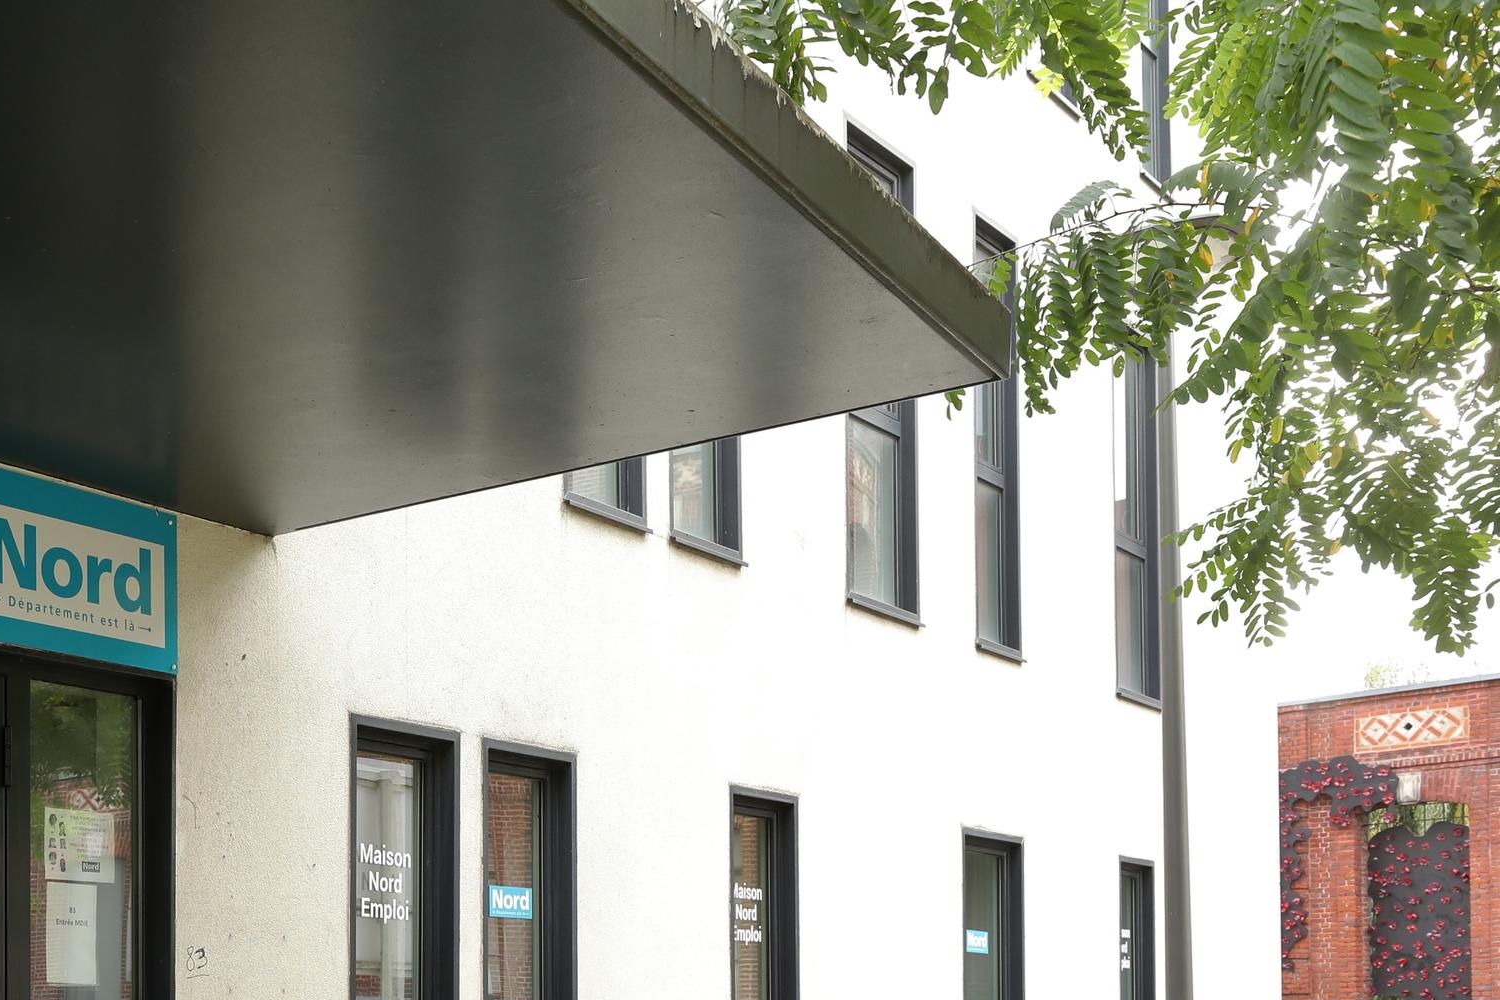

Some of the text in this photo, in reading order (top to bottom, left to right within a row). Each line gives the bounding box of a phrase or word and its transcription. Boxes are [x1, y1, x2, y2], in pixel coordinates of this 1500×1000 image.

[8, 595, 96, 624] Département
[100, 617, 119, 630] est
[124, 619, 135, 632] là
[360, 842, 411, 868] Maison
[369, 870, 402, 893] Nord
[361, 897, 409, 924] Emploi
[491, 889, 530, 910] Nord
[56, 918, 74, 926] Entrée
[735, 903, 757, 920] Nord
[967, 933, 988, 948] Nord
[186, 946, 208, 972] 83
